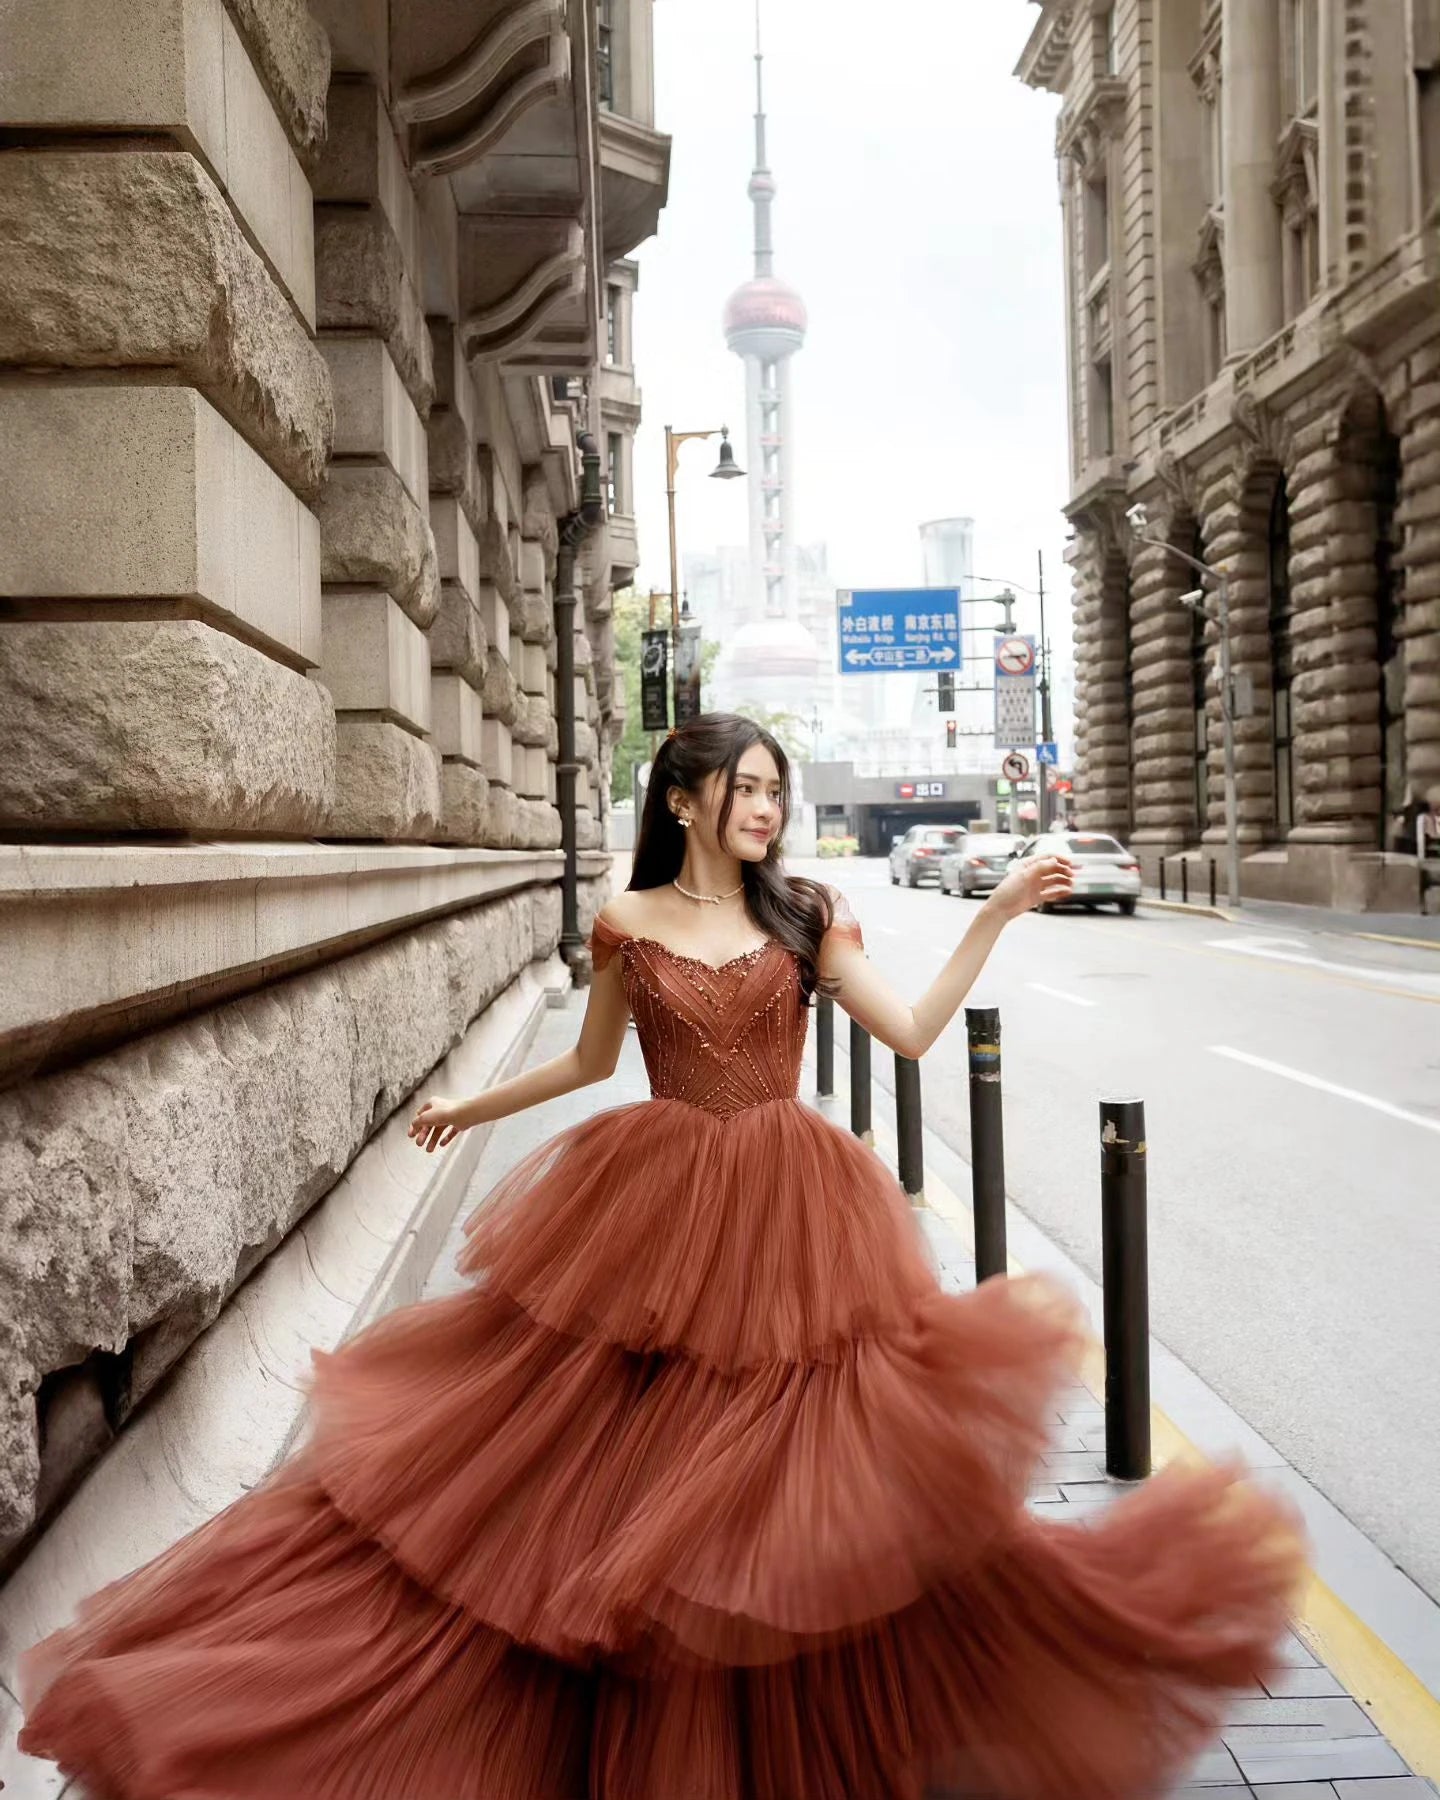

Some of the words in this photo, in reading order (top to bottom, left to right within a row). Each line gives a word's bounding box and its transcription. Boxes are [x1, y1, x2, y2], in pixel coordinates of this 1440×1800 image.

[842, 615, 894, 632] 外白渡桥
[905, 614, 957, 630] 南京东路
[876, 650, 926, 661] 中山东一路
[916, 783, 943, 796] 出口
